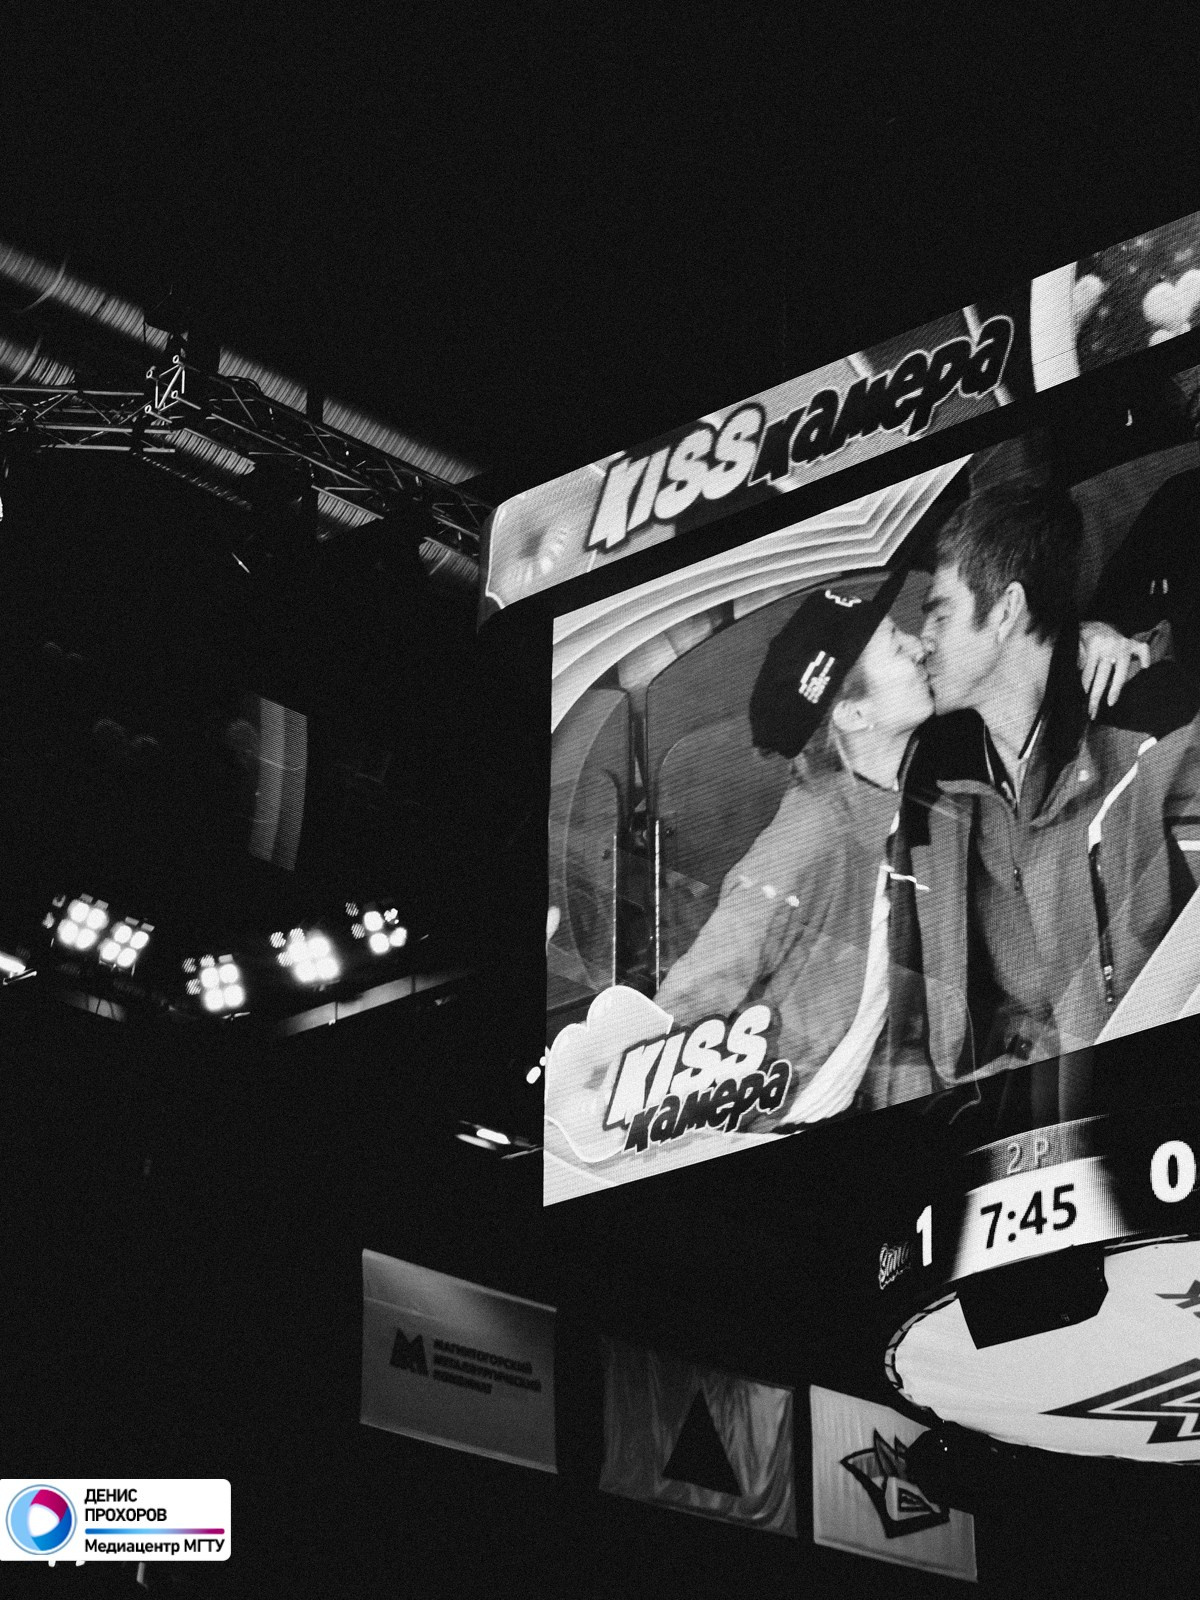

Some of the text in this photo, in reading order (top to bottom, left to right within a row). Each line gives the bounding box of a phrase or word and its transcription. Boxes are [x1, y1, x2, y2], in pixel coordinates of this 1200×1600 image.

[588, 314, 1014, 552] KISS камера
[606, 1004, 771, 1127] KISS
[623, 1059, 792, 1155] камера
[1150, 1139, 1197, 1203] 0
[916, 1204, 933, 1267] 1
[980, 1183, 1077, 1249] 7:45
